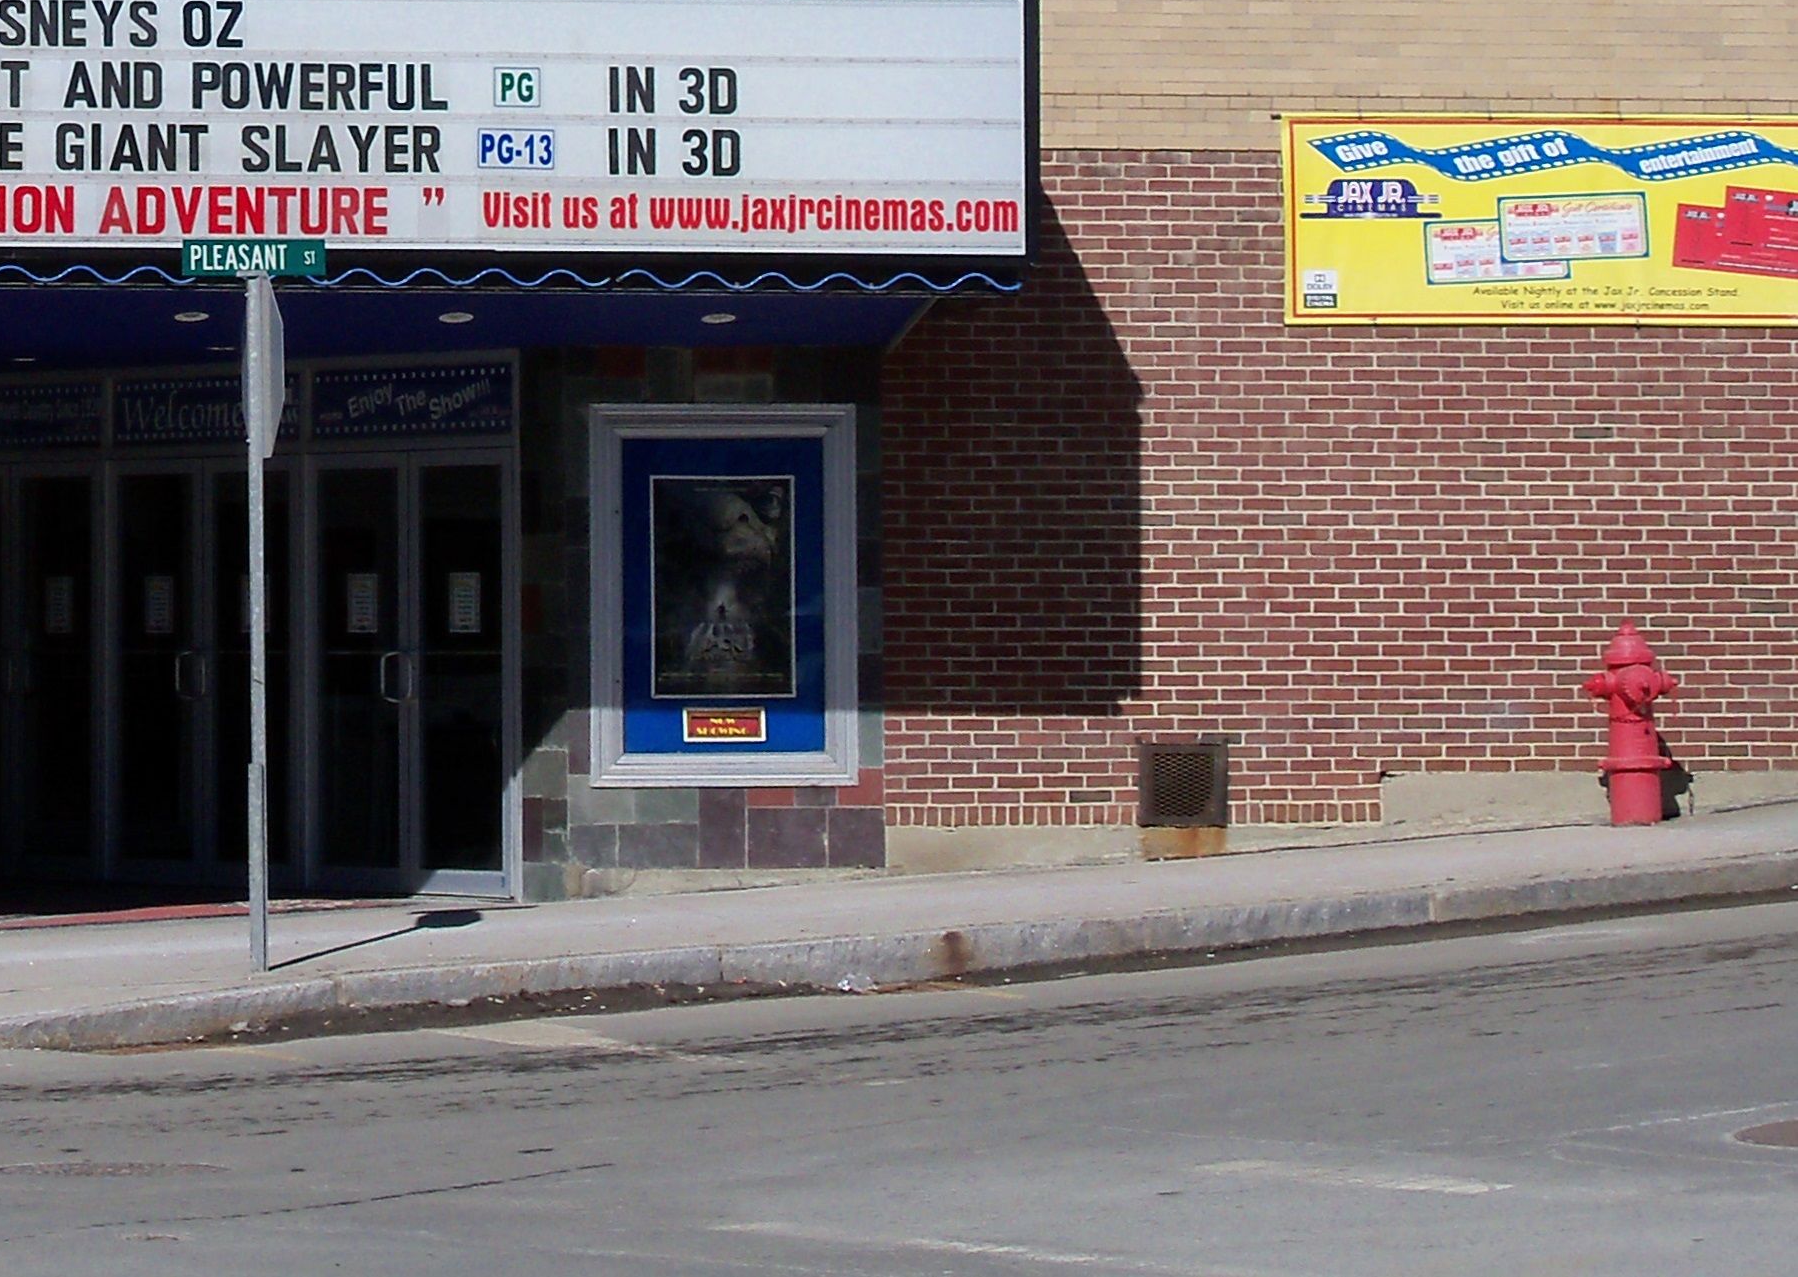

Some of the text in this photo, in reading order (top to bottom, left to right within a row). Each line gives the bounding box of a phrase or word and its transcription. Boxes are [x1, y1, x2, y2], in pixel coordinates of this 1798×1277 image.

[182, 1, 244, 48] OZ
[63, 61, 162, 109] AND
[191, 63, 449, 111] POWERFUL
[501, 72, 534, 102] PG
[608, 66, 655, 113] IN
[678, 67, 738, 115] 3D
[55, 123, 208, 172] GIANT
[241, 125, 441, 174] SLAYER
[480, 134, 553, 166] PG-13
[608, 128, 656, 176] IN
[682, 128, 741, 177] 3D
[1335, 137, 1759, 174] Give the gift of entertainment
[1337, 181, 1406, 203] JAX JR.
[1337, 204, 1406, 212] CINEMAS
[99, 186, 388, 236] ADVENTURE
[483, 191, 1019, 233] Visit us at www.jaxjrcinemas.com
[190, 244, 316, 271] PLEASANT ST
[1472, 286, 1518, 296] Available
[1523, 286, 1562, 298] Nightly
[1566, 287, 1577, 295] at
[1582, 286, 1598, 295] the
[1603, 286, 1622, 295] Jax
[1648, 287, 1702, 297] Concession
[1501, 300, 1524, 309] Visit
[1529, 301, 1540, 309] us
[1544, 300, 1573, 309] online
[1578, 301, 1589, 309] at
[122, 389, 243, 432] Welcome
[347, 383, 393, 420] Enjoy
[394, 389, 427, 417] The
